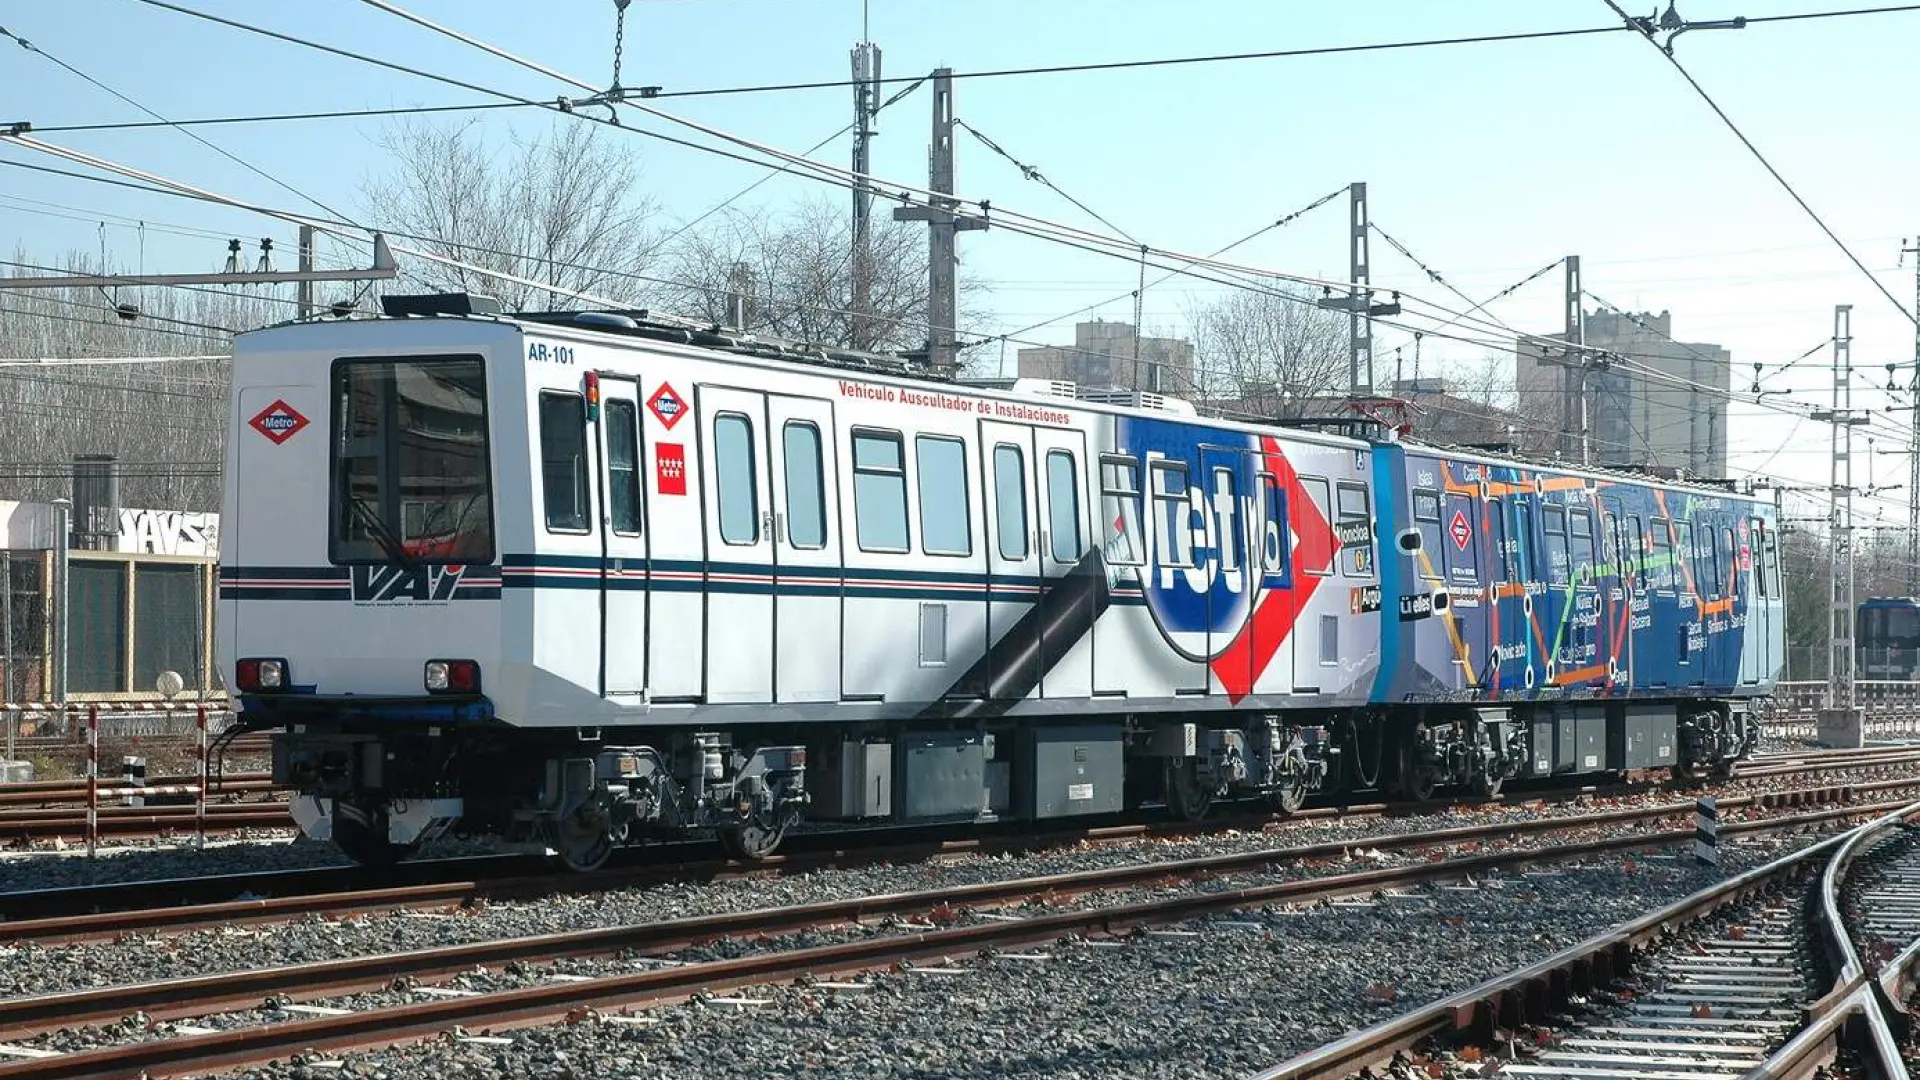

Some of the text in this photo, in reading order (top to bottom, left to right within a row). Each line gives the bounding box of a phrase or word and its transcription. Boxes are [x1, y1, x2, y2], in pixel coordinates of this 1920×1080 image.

[656, 400, 679, 414] Metro
[899, 388, 972, 412] Auscultador
[977, 401, 991, 415] de
[995, 403, 1070, 425] Instalaciones
[265, 417, 293, 429] Metro
